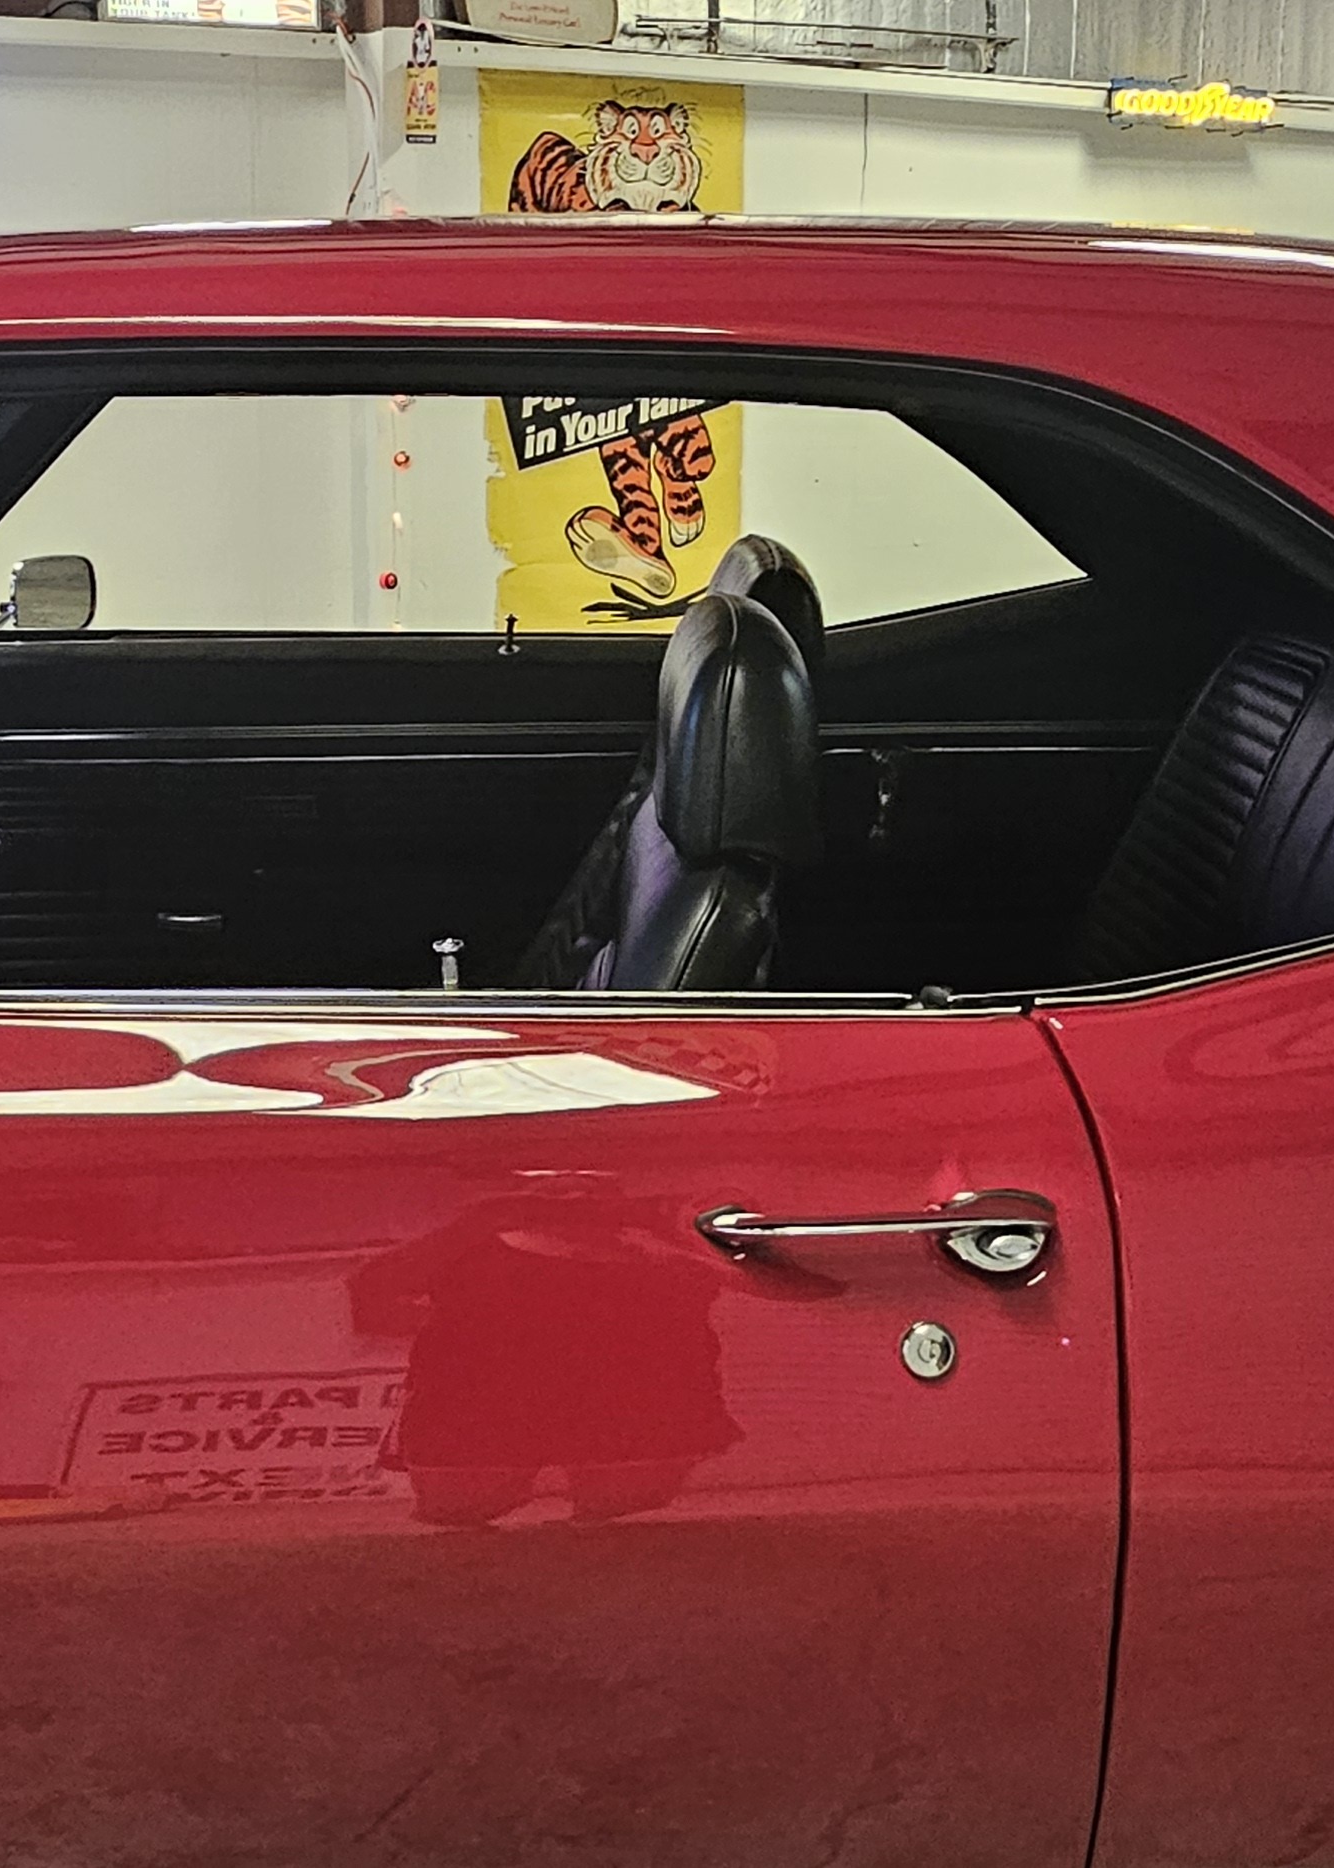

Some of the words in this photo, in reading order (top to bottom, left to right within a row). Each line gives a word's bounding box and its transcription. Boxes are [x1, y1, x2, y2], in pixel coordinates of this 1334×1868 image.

[1115, 83, 1275, 125] GOODYEAR
[521, 396, 576, 419] Pu
[524, 424, 557, 459] in
[560, 403, 634, 448] Your
[634, 397, 707, 425] Tan
